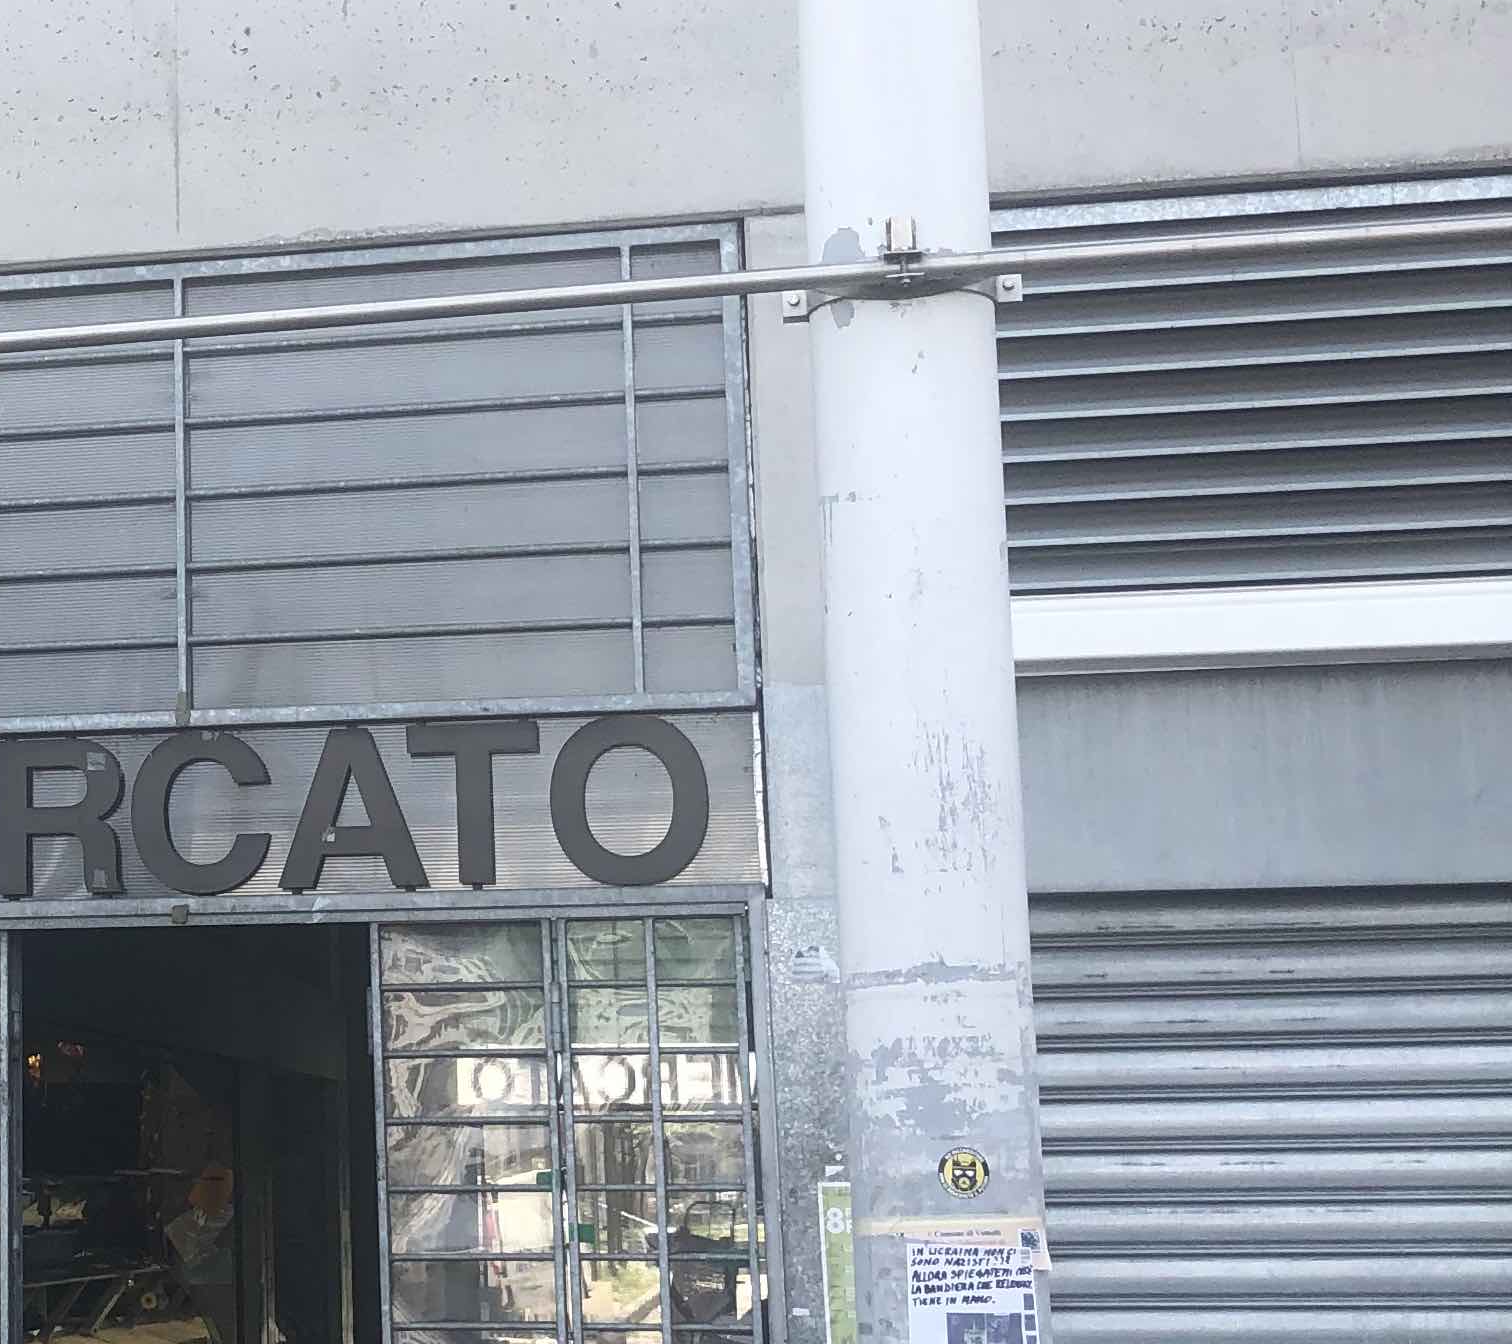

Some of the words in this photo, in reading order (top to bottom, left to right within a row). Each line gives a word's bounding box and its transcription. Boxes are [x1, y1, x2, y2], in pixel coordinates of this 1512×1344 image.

[929, 1247, 979, 1256] UCRAINA
[911, 1258, 940, 1267] SONO
[912, 1270, 947, 1282] ALLORA
[924, 1282, 974, 1294] BANDIERA
